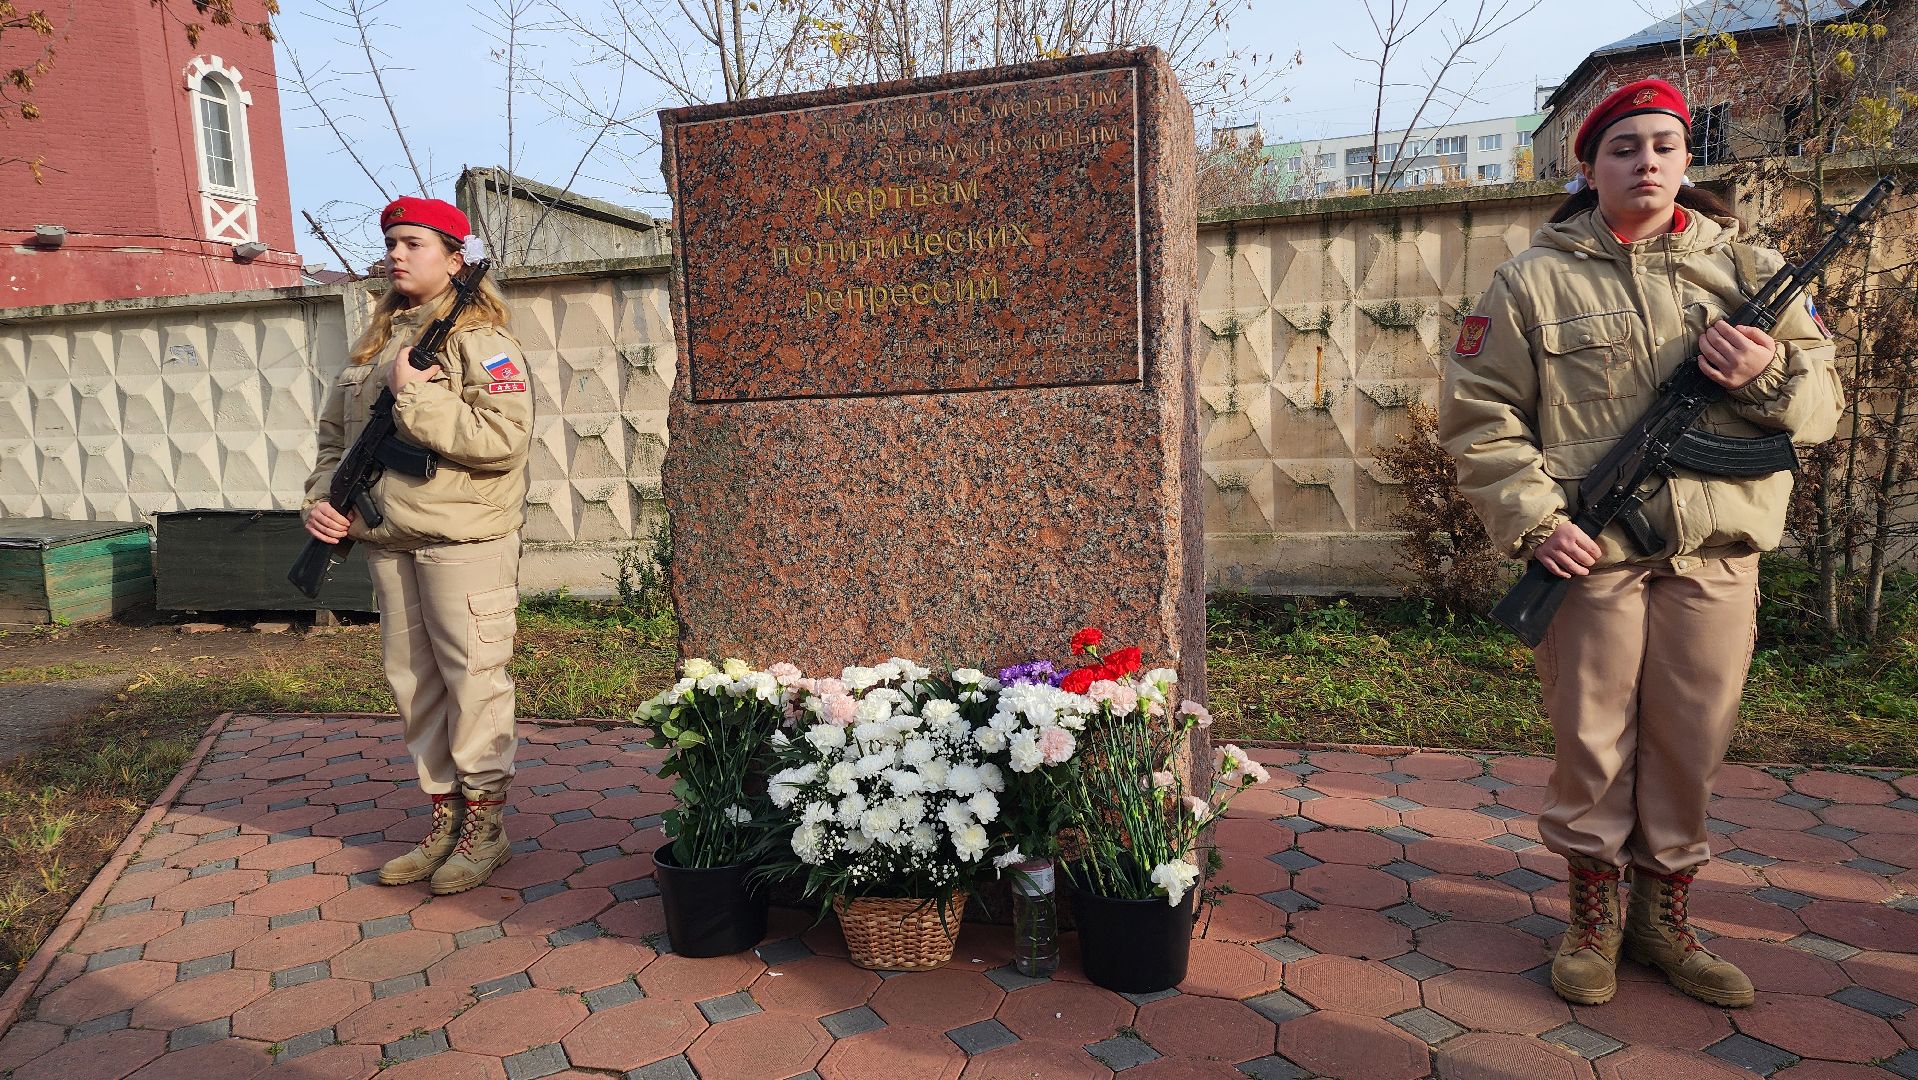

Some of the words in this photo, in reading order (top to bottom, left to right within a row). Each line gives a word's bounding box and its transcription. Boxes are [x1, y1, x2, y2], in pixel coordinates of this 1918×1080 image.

[865, 111, 943, 136] нужно
[953, 104, 982, 125] не
[932, 136, 1011, 166] нужно
[1015, 124, 1119, 151] живым
[813, 178, 979, 219] Жертвам
[774, 223, 1032, 267] политических
[805, 269, 1000, 318] репрессий
